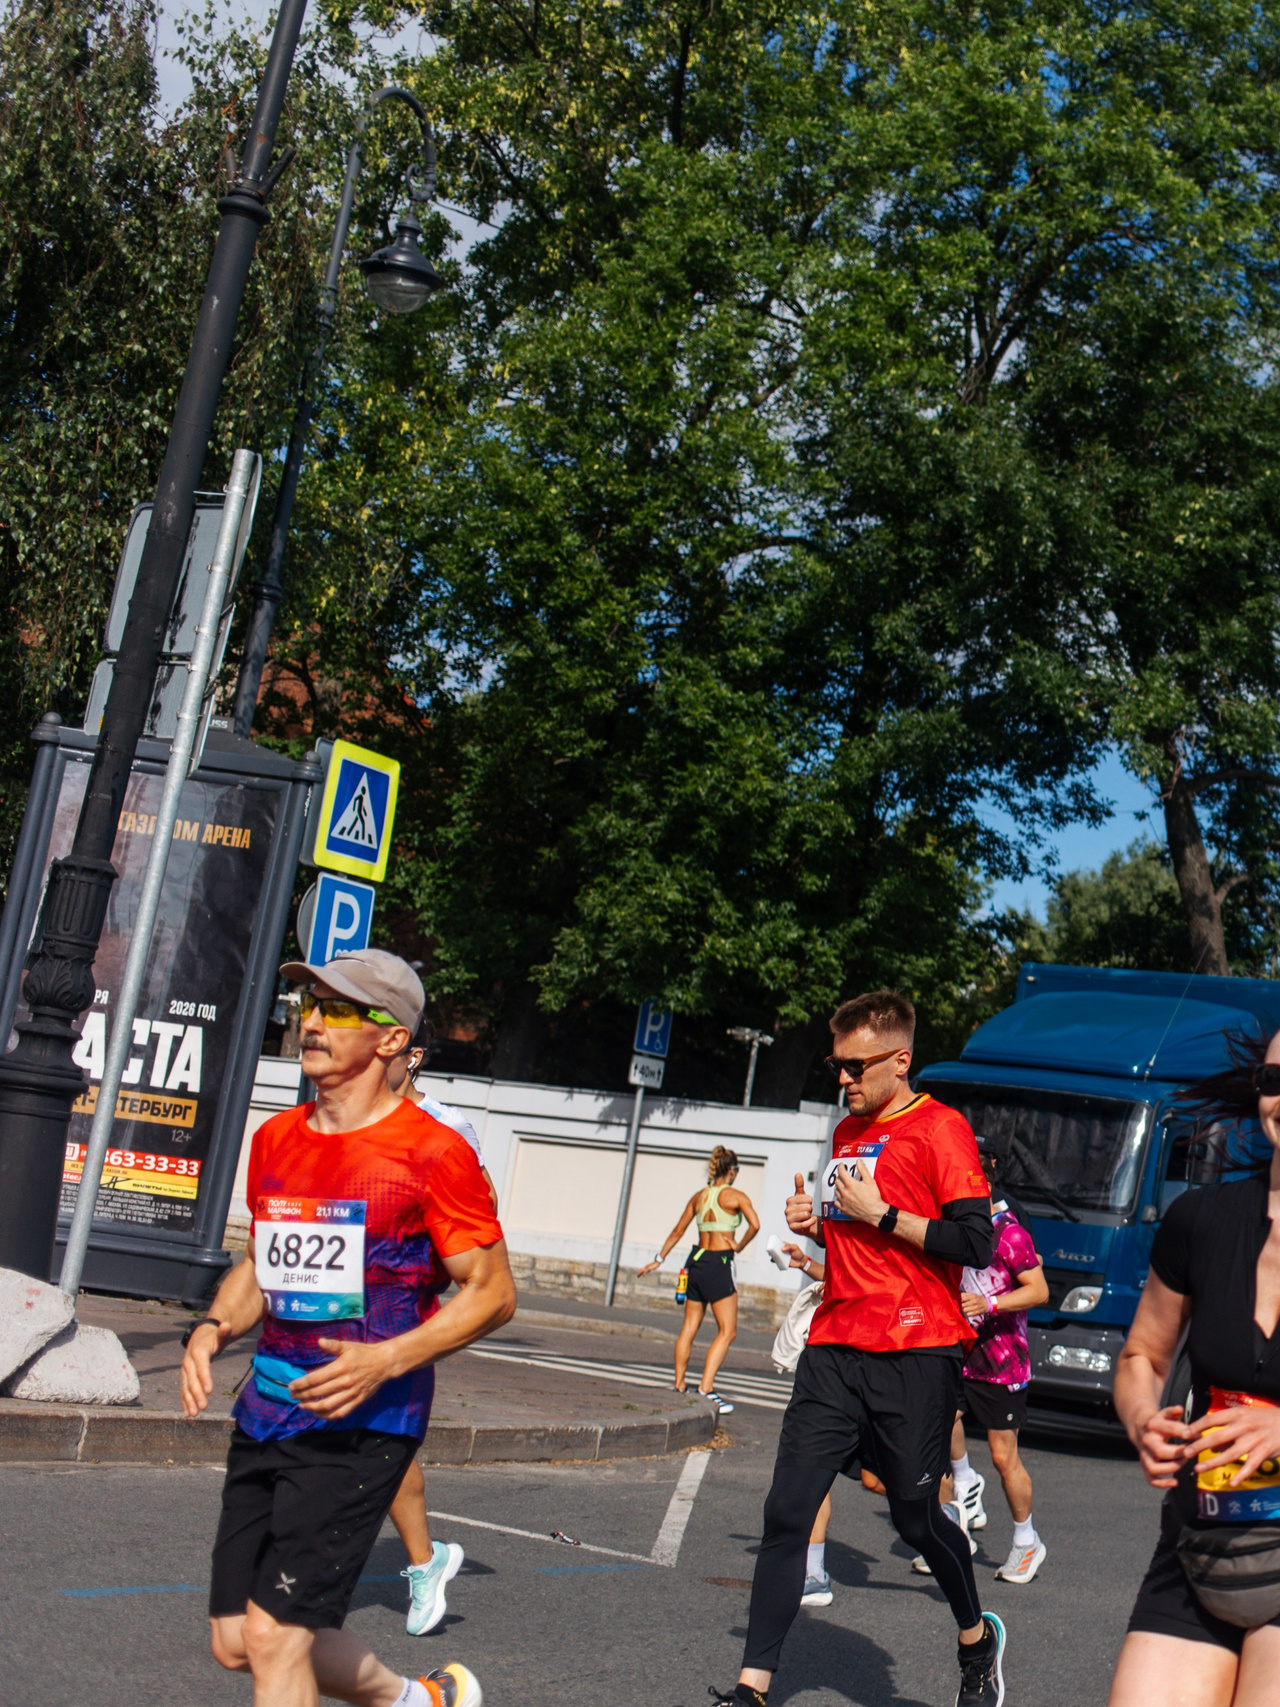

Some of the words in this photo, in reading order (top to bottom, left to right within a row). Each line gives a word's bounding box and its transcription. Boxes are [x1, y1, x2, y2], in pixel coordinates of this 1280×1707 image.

[202, 824, 251, 849] АРЕНА
[169, 1000, 195, 1017] 2026
[196, 1004, 217, 1022] ГОД
[171, 1129, 192, 1143] 12+
[316, 1206, 332, 1217] 21,1
[267, 1232, 346, 1270] 6822
[282, 1273, 319, 1284] ДЕНИС
[1205, 1494, 1218, 1516] D
